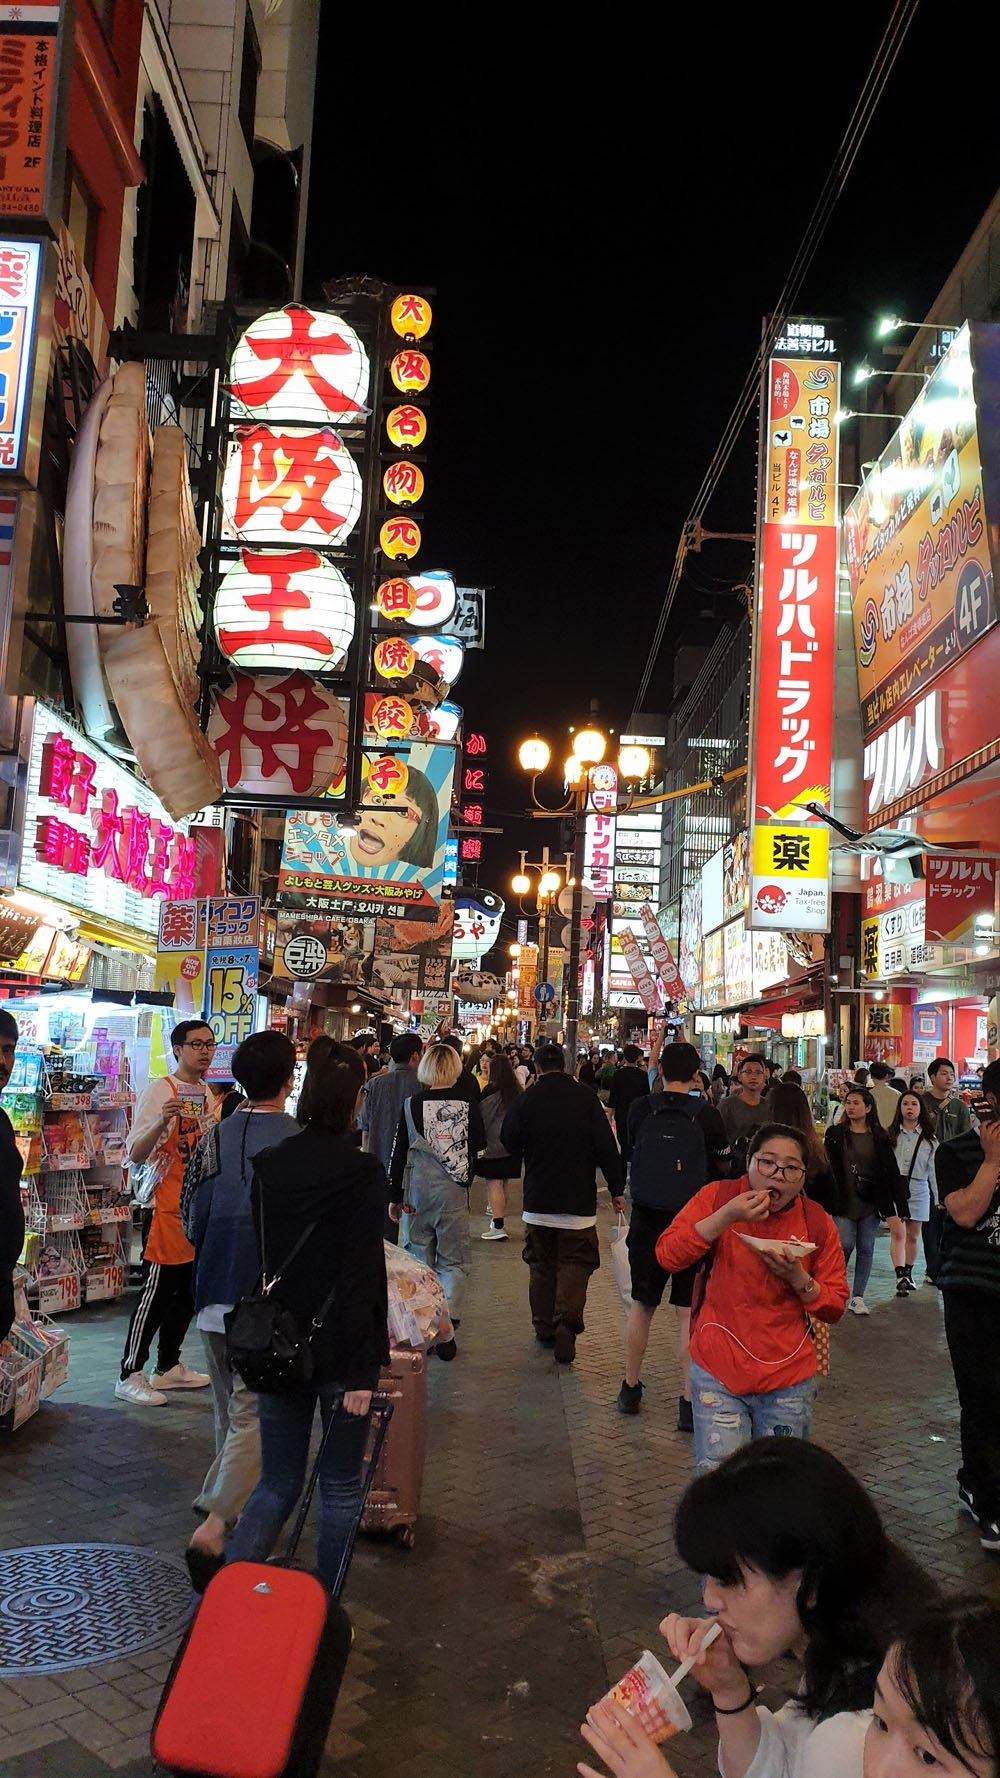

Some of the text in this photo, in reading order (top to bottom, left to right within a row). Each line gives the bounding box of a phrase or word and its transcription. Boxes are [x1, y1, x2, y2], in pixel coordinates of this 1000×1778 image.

[27, 40, 49, 147] 本格インド料理店
[24, 157, 41, 168] 2F
[775, 337, 837, 352] 法善寺ビル
[806, 395, 833, 521] 市場タッカルビ
[212, 306, 371, 793] 大阪王将
[959, 575, 983, 635] 4F
[774, 532, 818, 784] ツルハドラッグ
[864, 690, 943, 814] ツルハ
[288, 811, 344, 828] よしも
[288, 828, 345, 847] エンタメ
[592, 794, 612, 888] ジャンカラ
[286, 847, 346, 866] ショップ
[773, 835, 811, 872] 薬
[929, 860, 993, 882] ツルハ
[284, 876, 424, 900] よしもと芸人グッズ・大阪みやげ
[798, 888, 826, 898] Japan.
[929, 884, 978, 898] ドラッグ
[795, 898, 826, 907] Tax-free
[806, 907, 826, 915] Shop
[163, 901, 256, 944] 薬 ダイコク
[279, 912, 323, 921] MAMESHIBA
[885, 914, 902, 935] くすり
[207, 921, 250, 935] ドラッグ
[864, 924, 879, 974] 薬
[185, 957, 200, 966] NOW
[182, 968, 198, 977] SALE!
[210, 967, 253, 1015] 15%
[416, 990, 449, 998] PIZZA
[438, 1003, 450, 1012] 2F
[208, 1014, 252, 1045] OFF
[869, 1007, 890, 1032] 薬
[75, 1095, 91, 1105] 398
[113, 1207, 129, 1217] 498
[59, 1276, 78, 1300] 798
[105, 1266, 123, 1289] 798
